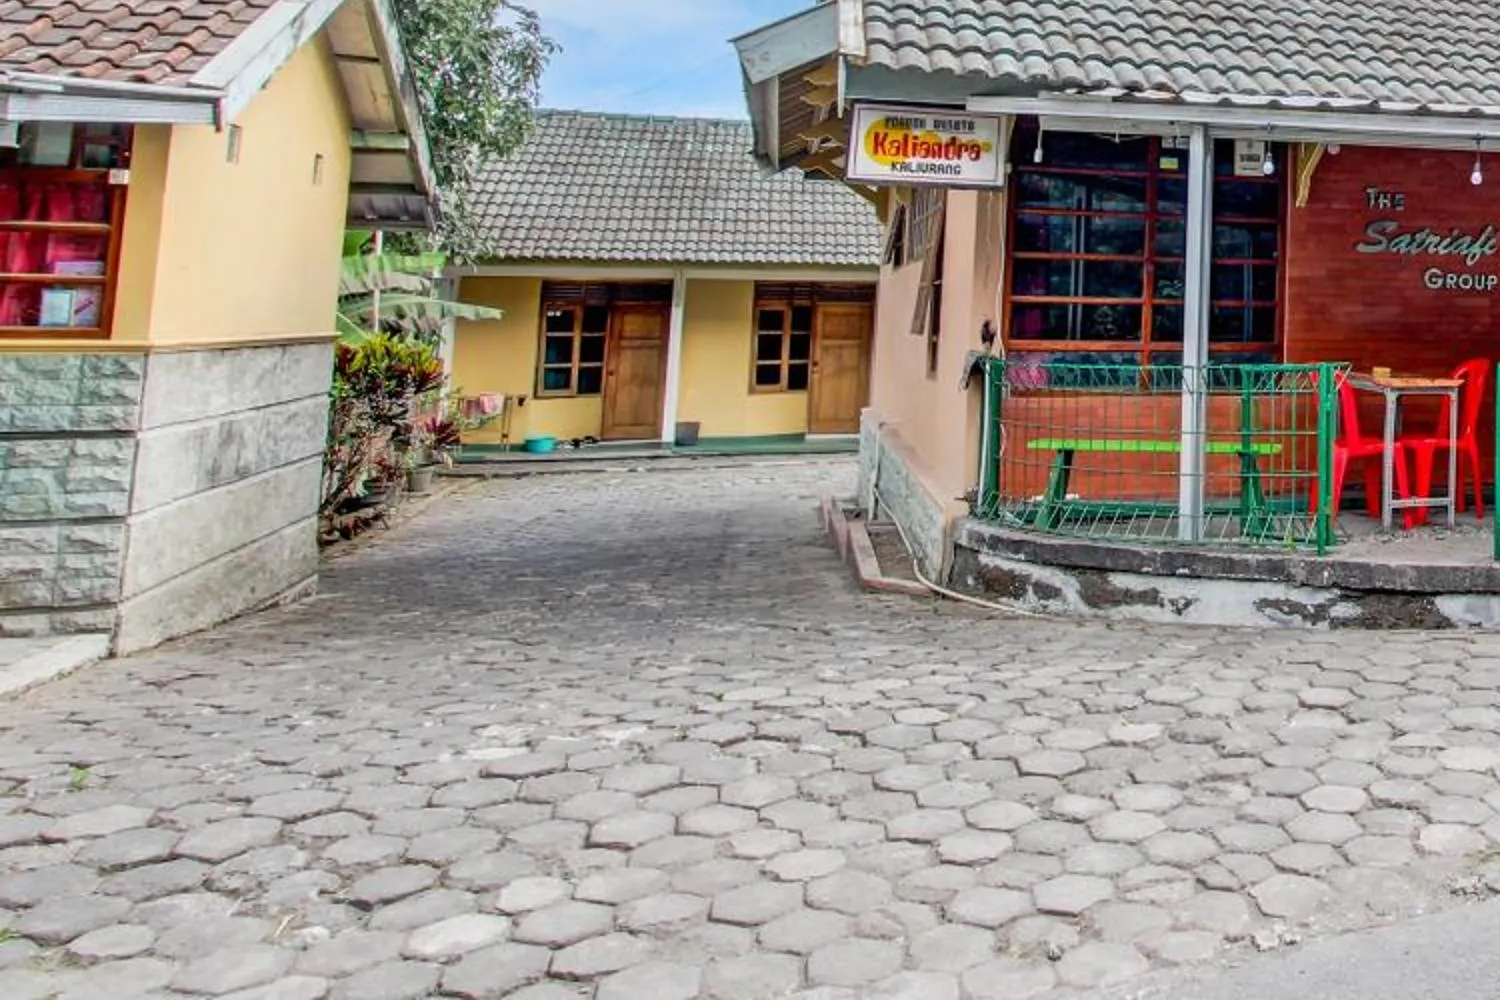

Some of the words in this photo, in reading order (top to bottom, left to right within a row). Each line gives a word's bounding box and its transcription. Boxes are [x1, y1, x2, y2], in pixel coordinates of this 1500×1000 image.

[873, 132, 981, 161] Kaliandra
[891, 162, 962, 175] KALIURANG
[1366, 187, 1405, 210] THE
[1424, 267, 1498, 290] GROUP
